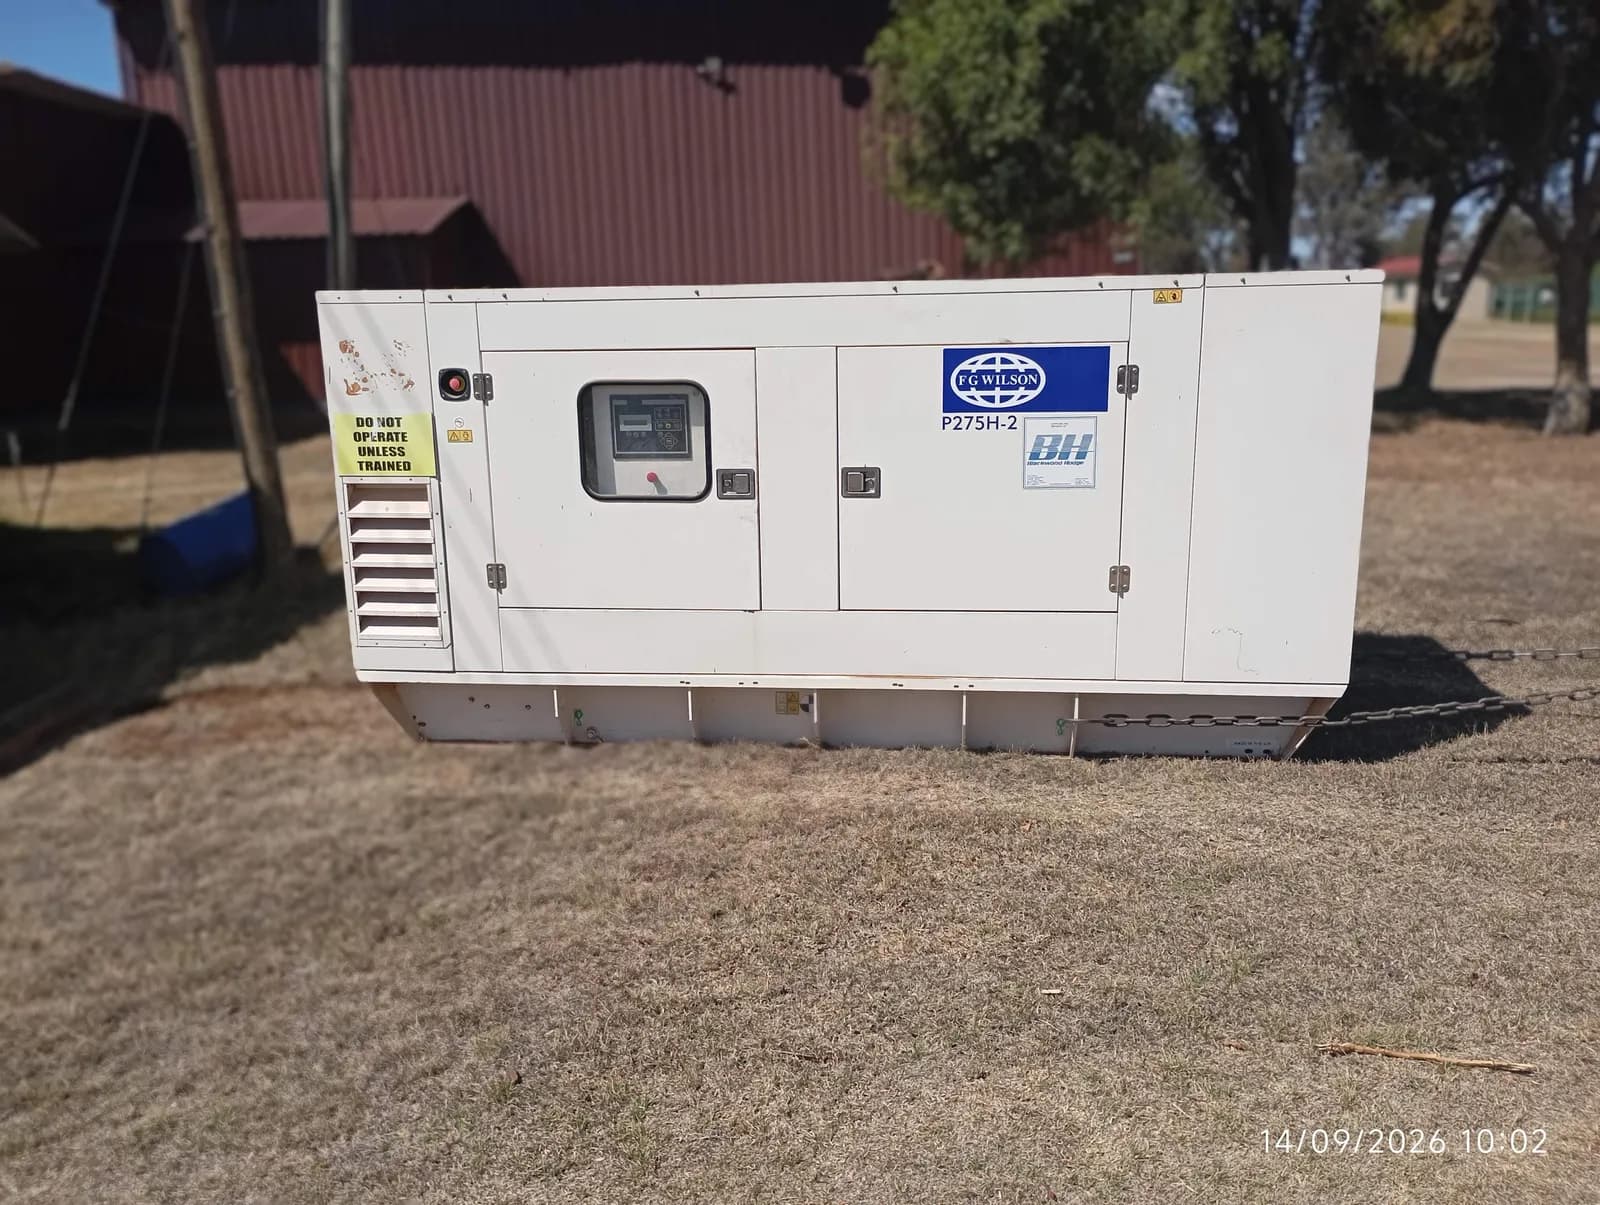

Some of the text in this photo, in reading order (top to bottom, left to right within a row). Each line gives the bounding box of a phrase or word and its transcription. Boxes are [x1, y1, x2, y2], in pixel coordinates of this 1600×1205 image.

[958, 374, 1038, 386] FG WILSON
[355, 416, 402, 428] DO NOT
[942, 415, 1017, 431] P275H-2
[353, 431, 409, 443] OPERATE
[357, 446, 406, 457] UNLESS
[1028, 433, 1093, 460] BH
[357, 460, 412, 472] TRAINED
